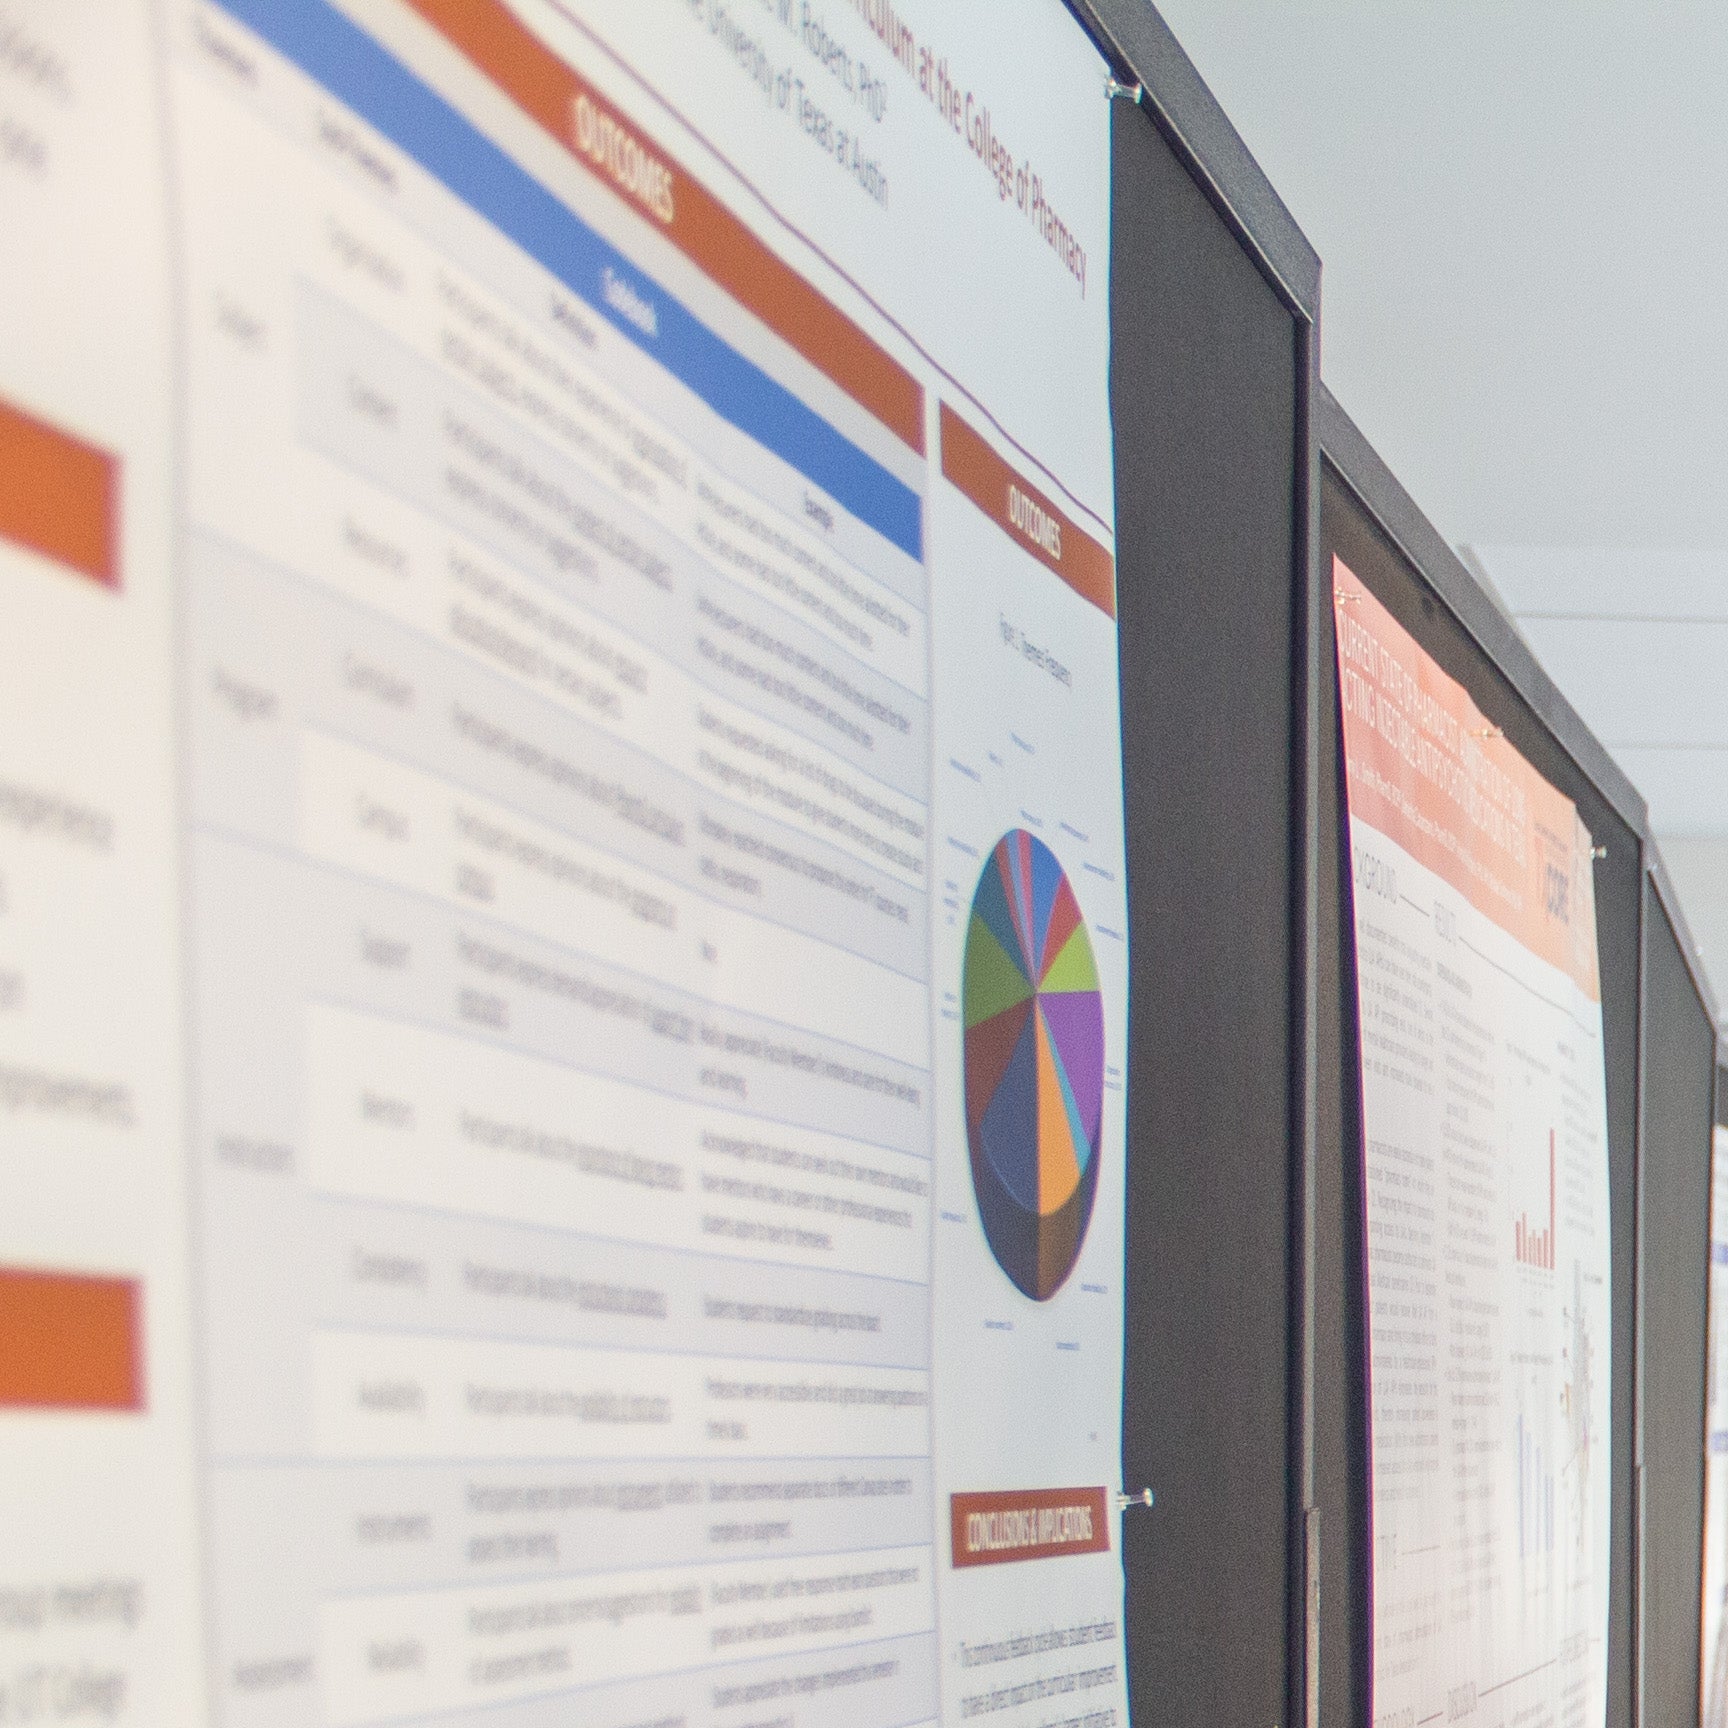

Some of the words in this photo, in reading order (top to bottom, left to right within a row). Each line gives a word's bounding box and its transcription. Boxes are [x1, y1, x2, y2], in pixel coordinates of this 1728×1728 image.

[570, 92, 676, 225] OUTCOMES
[796, 76, 835, 155] Texas
[834, 128, 850, 171] at
[850, 135, 889, 212] Austin
[918, 45, 937, 104] at
[937, 56, 962, 136] the
[964, 91, 1015, 202] College
[1016, 160, 1031, 217] of
[1032, 171, 1087, 300] Pharmacy
[1006, 482, 1063, 561] OUTCOMES
[966, 1509, 1032, 1553] CONCLUSIONS
